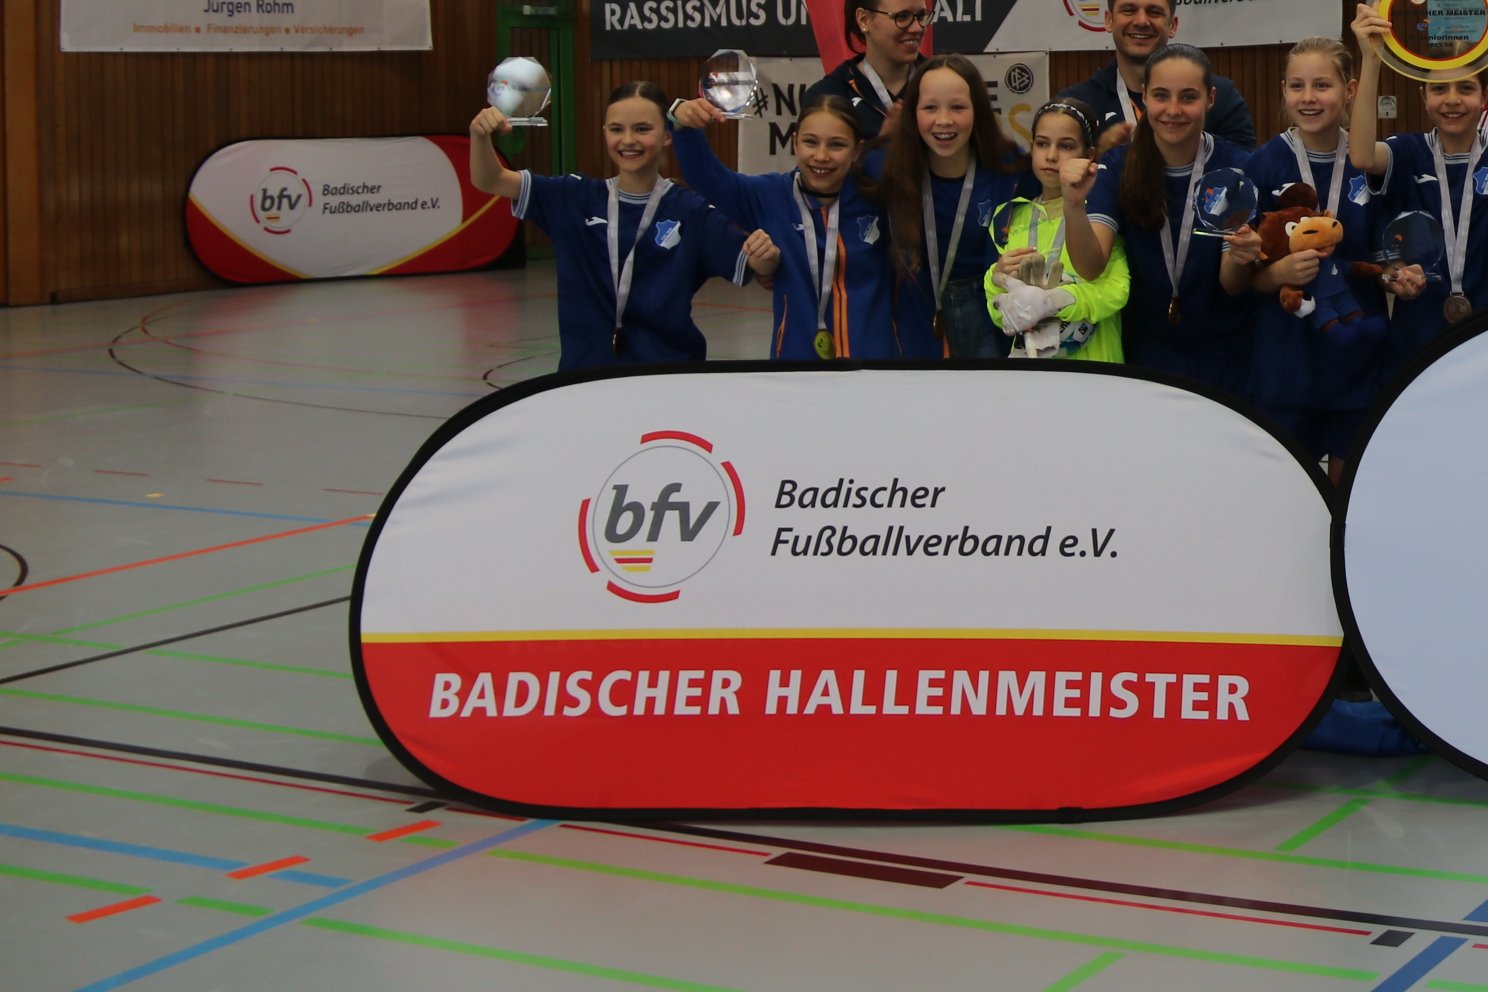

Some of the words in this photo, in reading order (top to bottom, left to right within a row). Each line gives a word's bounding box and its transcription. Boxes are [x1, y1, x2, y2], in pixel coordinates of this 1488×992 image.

[260, 186, 302, 213] bfv
[321, 182, 382, 197] Badischer
[321, 199, 418, 215] Fußballverband
[420, 197, 441, 210] e.V.
[774, 477, 946, 509] Badischer
[603, 481, 721, 545] bfv
[769, 525, 1052, 558] Fußballverband
[1058, 527, 1120, 559] e.V.
[428, 669, 743, 719] BADISCHER
[764, 669, 1253, 722] HALLENMEISTER
